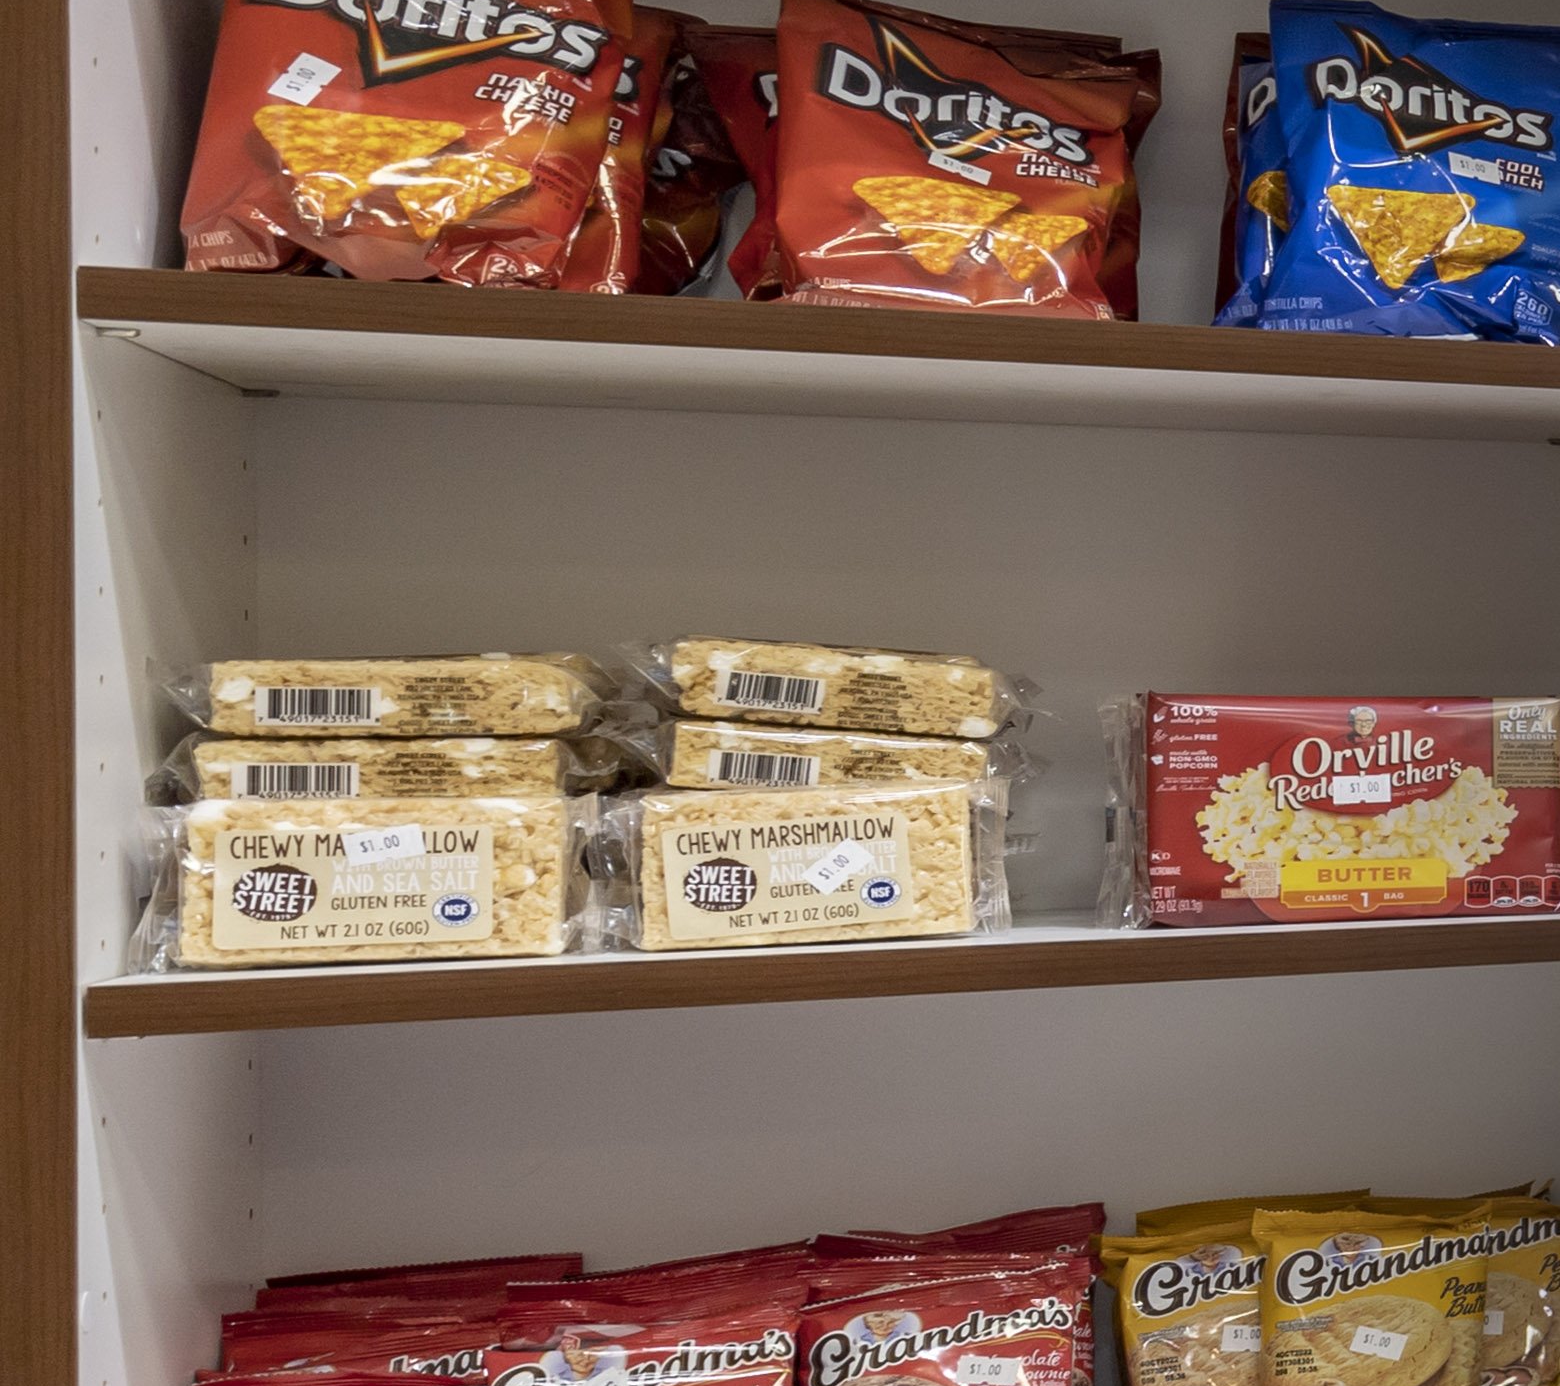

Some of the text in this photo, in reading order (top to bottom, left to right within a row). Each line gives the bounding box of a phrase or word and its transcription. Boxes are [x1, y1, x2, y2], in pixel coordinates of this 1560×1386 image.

[827, 48, 1089, 164] Doritos
[1315, 59, 1547, 146] Doritos
[1460, 159, 1486, 174] $1.00
[1518, 293, 1548, 313] 260
[1170, 706, 1218, 716] 100%
[1508, 706, 1547, 721] Only
[1500, 720, 1557, 733] REAL
[1292, 731, 1434, 778] Orville
[1350, 781, 1380, 795] $1.00
[359, 834, 400, 854] $1.00
[677, 818, 895, 856] CHEWY MARSHMALLOW
[230, 834, 303, 860] CHEWY
[430, 855, 479, 870] BUTTER
[768, 848, 803, 862] WITH
[818, 854, 850, 882] $1.00
[1318, 867, 1412, 882] BUTTER
[241, 871, 314, 893] SWEET
[331, 869, 478, 893] AND SEA SALT
[688, 866, 753, 886] SWEET
[684, 884, 754, 904] STREET
[870, 886, 891, 898] NSF
[1164, 886, 1176, 898] WT
[1470, 881, 1489, 892] 170
[232, 890, 314, 913] STREET
[330, 894, 427, 911] GLUTEN FREE
[1167, 901, 1177, 912] OZ
[1305, 892, 1404, 907] CLASSIC 1 BAG
[444, 904, 468, 917] NSF
[729, 905, 860, 929] NET WT OZ (60G)
[280, 921, 430, 940] NET WT OZ (60G)
[1233, 1327, 1261, 1341] $1.00
[1364, 1333, 1391, 1347] $1.00
[969, 1362, 1001, 1376] $1.00
